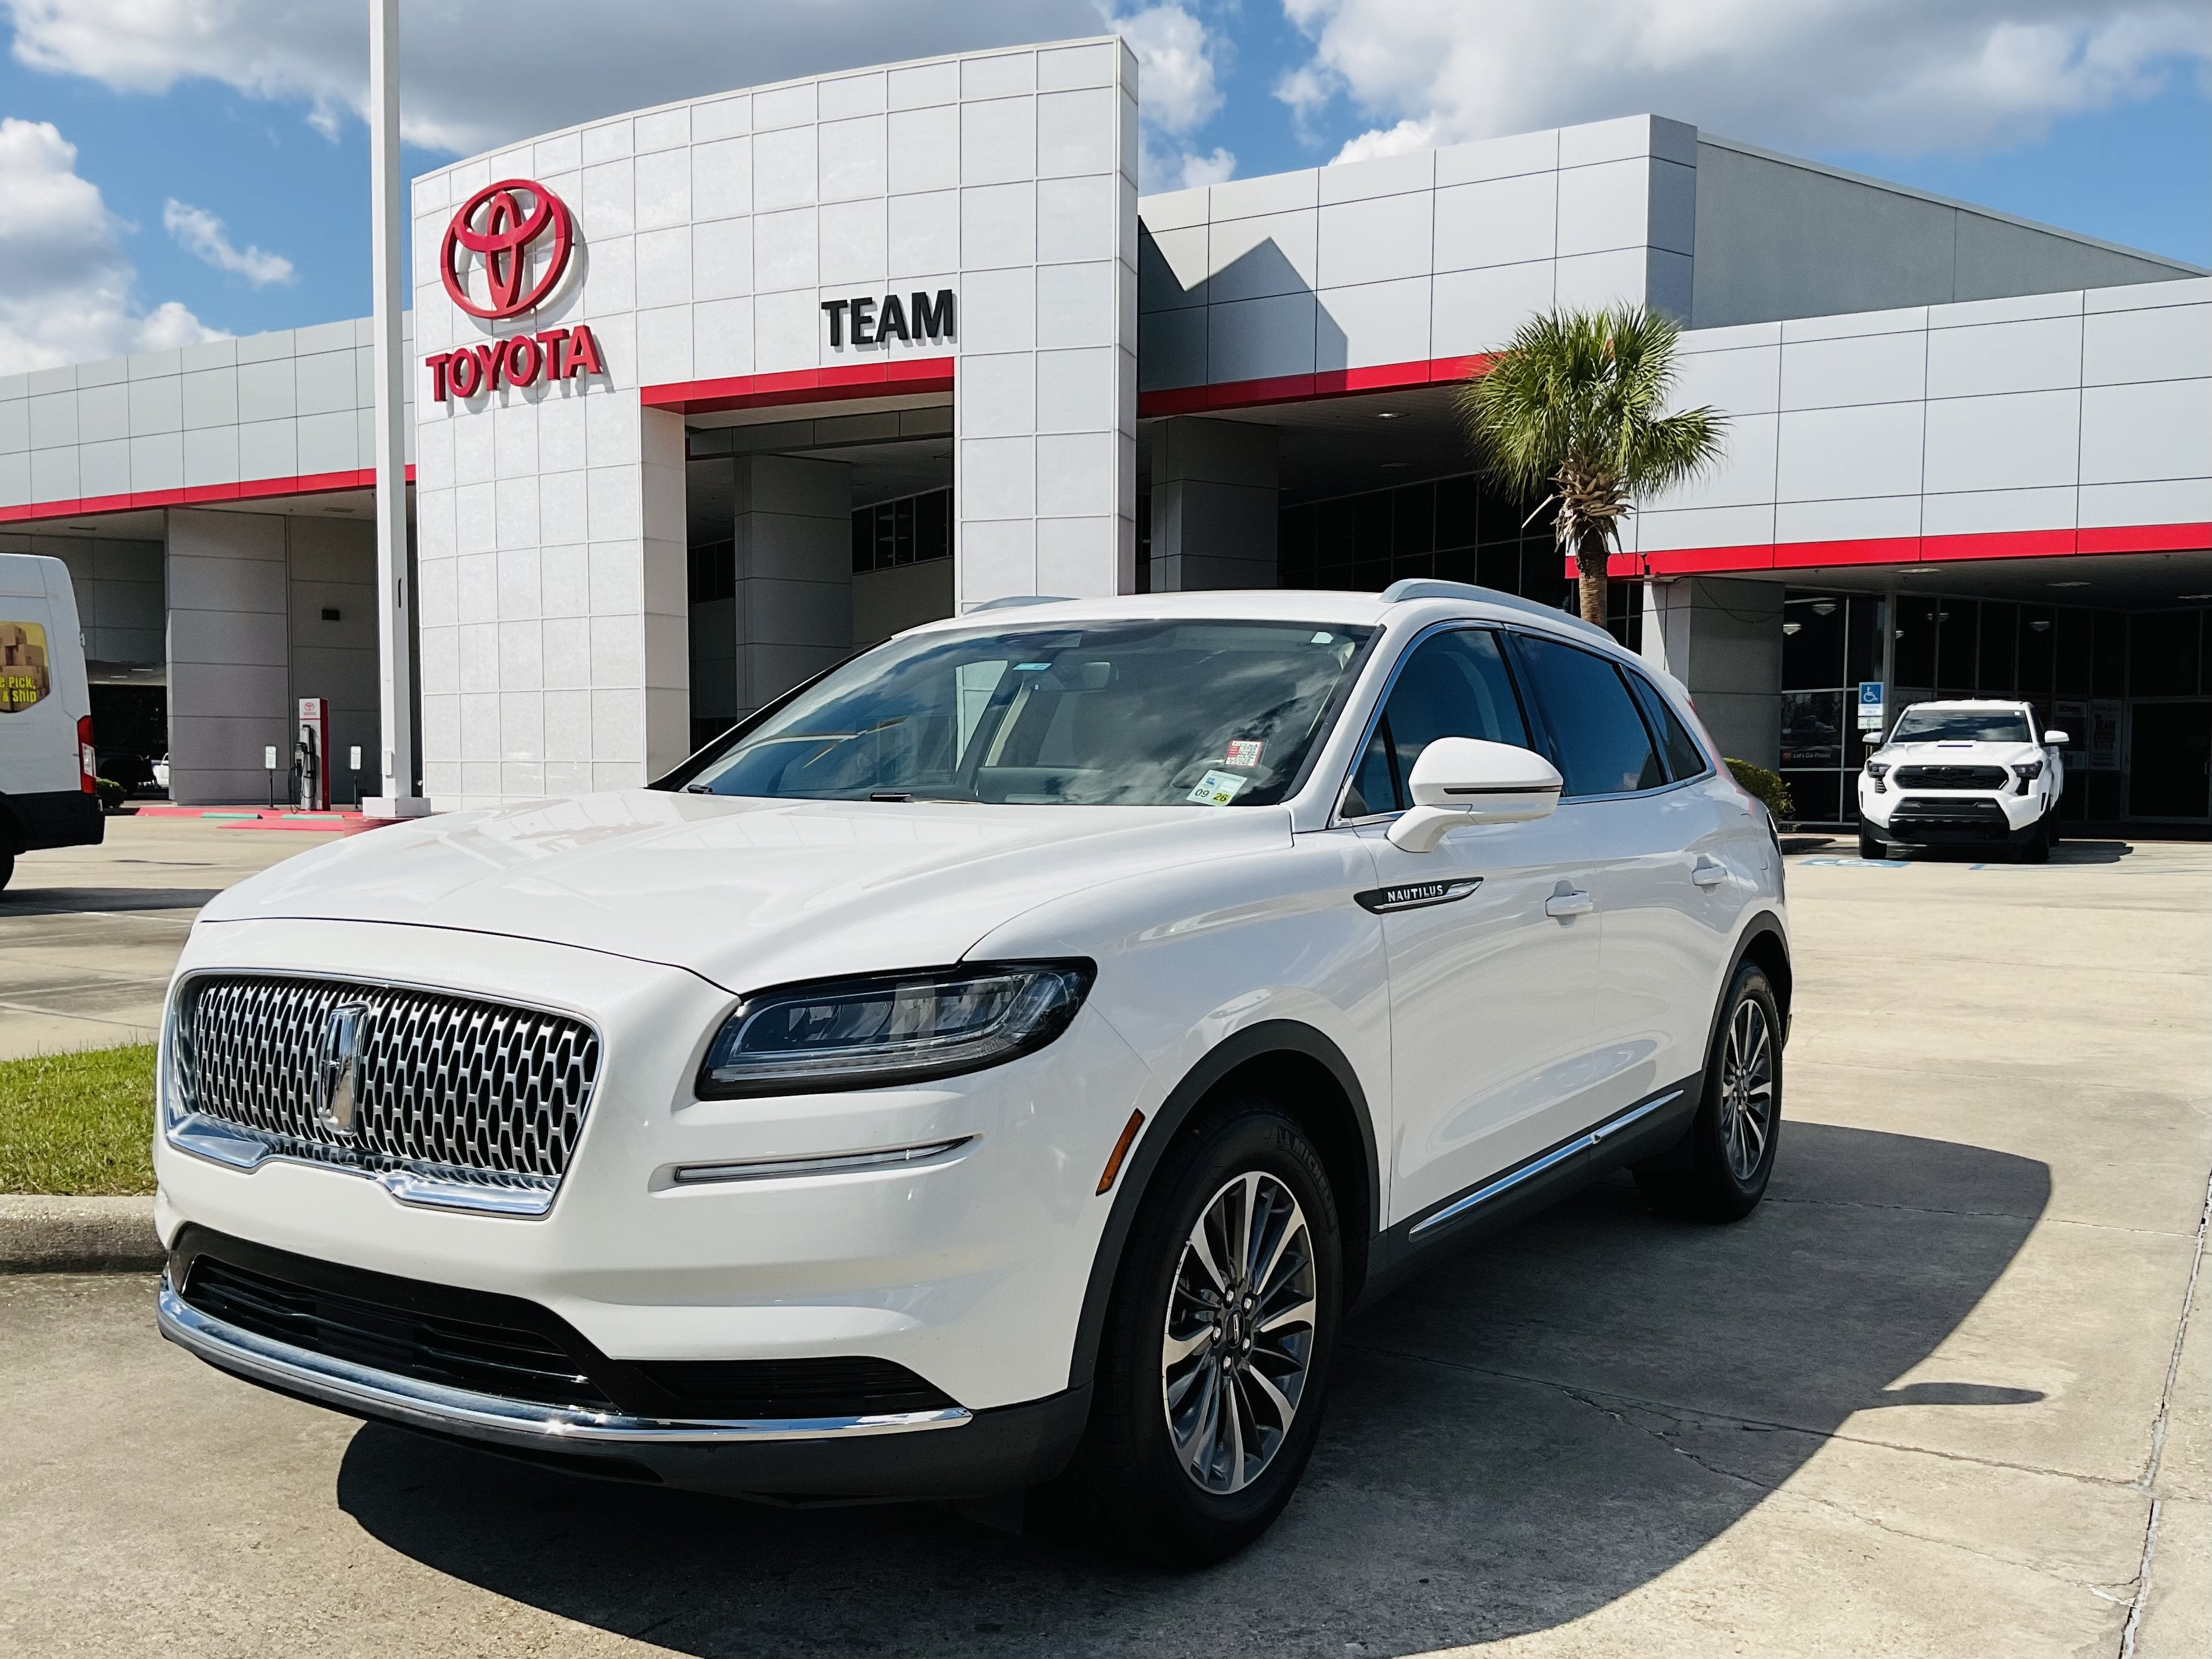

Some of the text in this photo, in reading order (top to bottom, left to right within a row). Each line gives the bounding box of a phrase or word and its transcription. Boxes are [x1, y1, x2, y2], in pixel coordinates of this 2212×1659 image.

[821, 289, 953, 347] TEAM
[425, 324, 603, 403] TOYOTA
[2, 691, 10, 702] &
[1195, 789, 1210, 798] 09
[1213, 793, 1229, 802] 26
[1387, 885, 1443, 902] NAUTILUS
